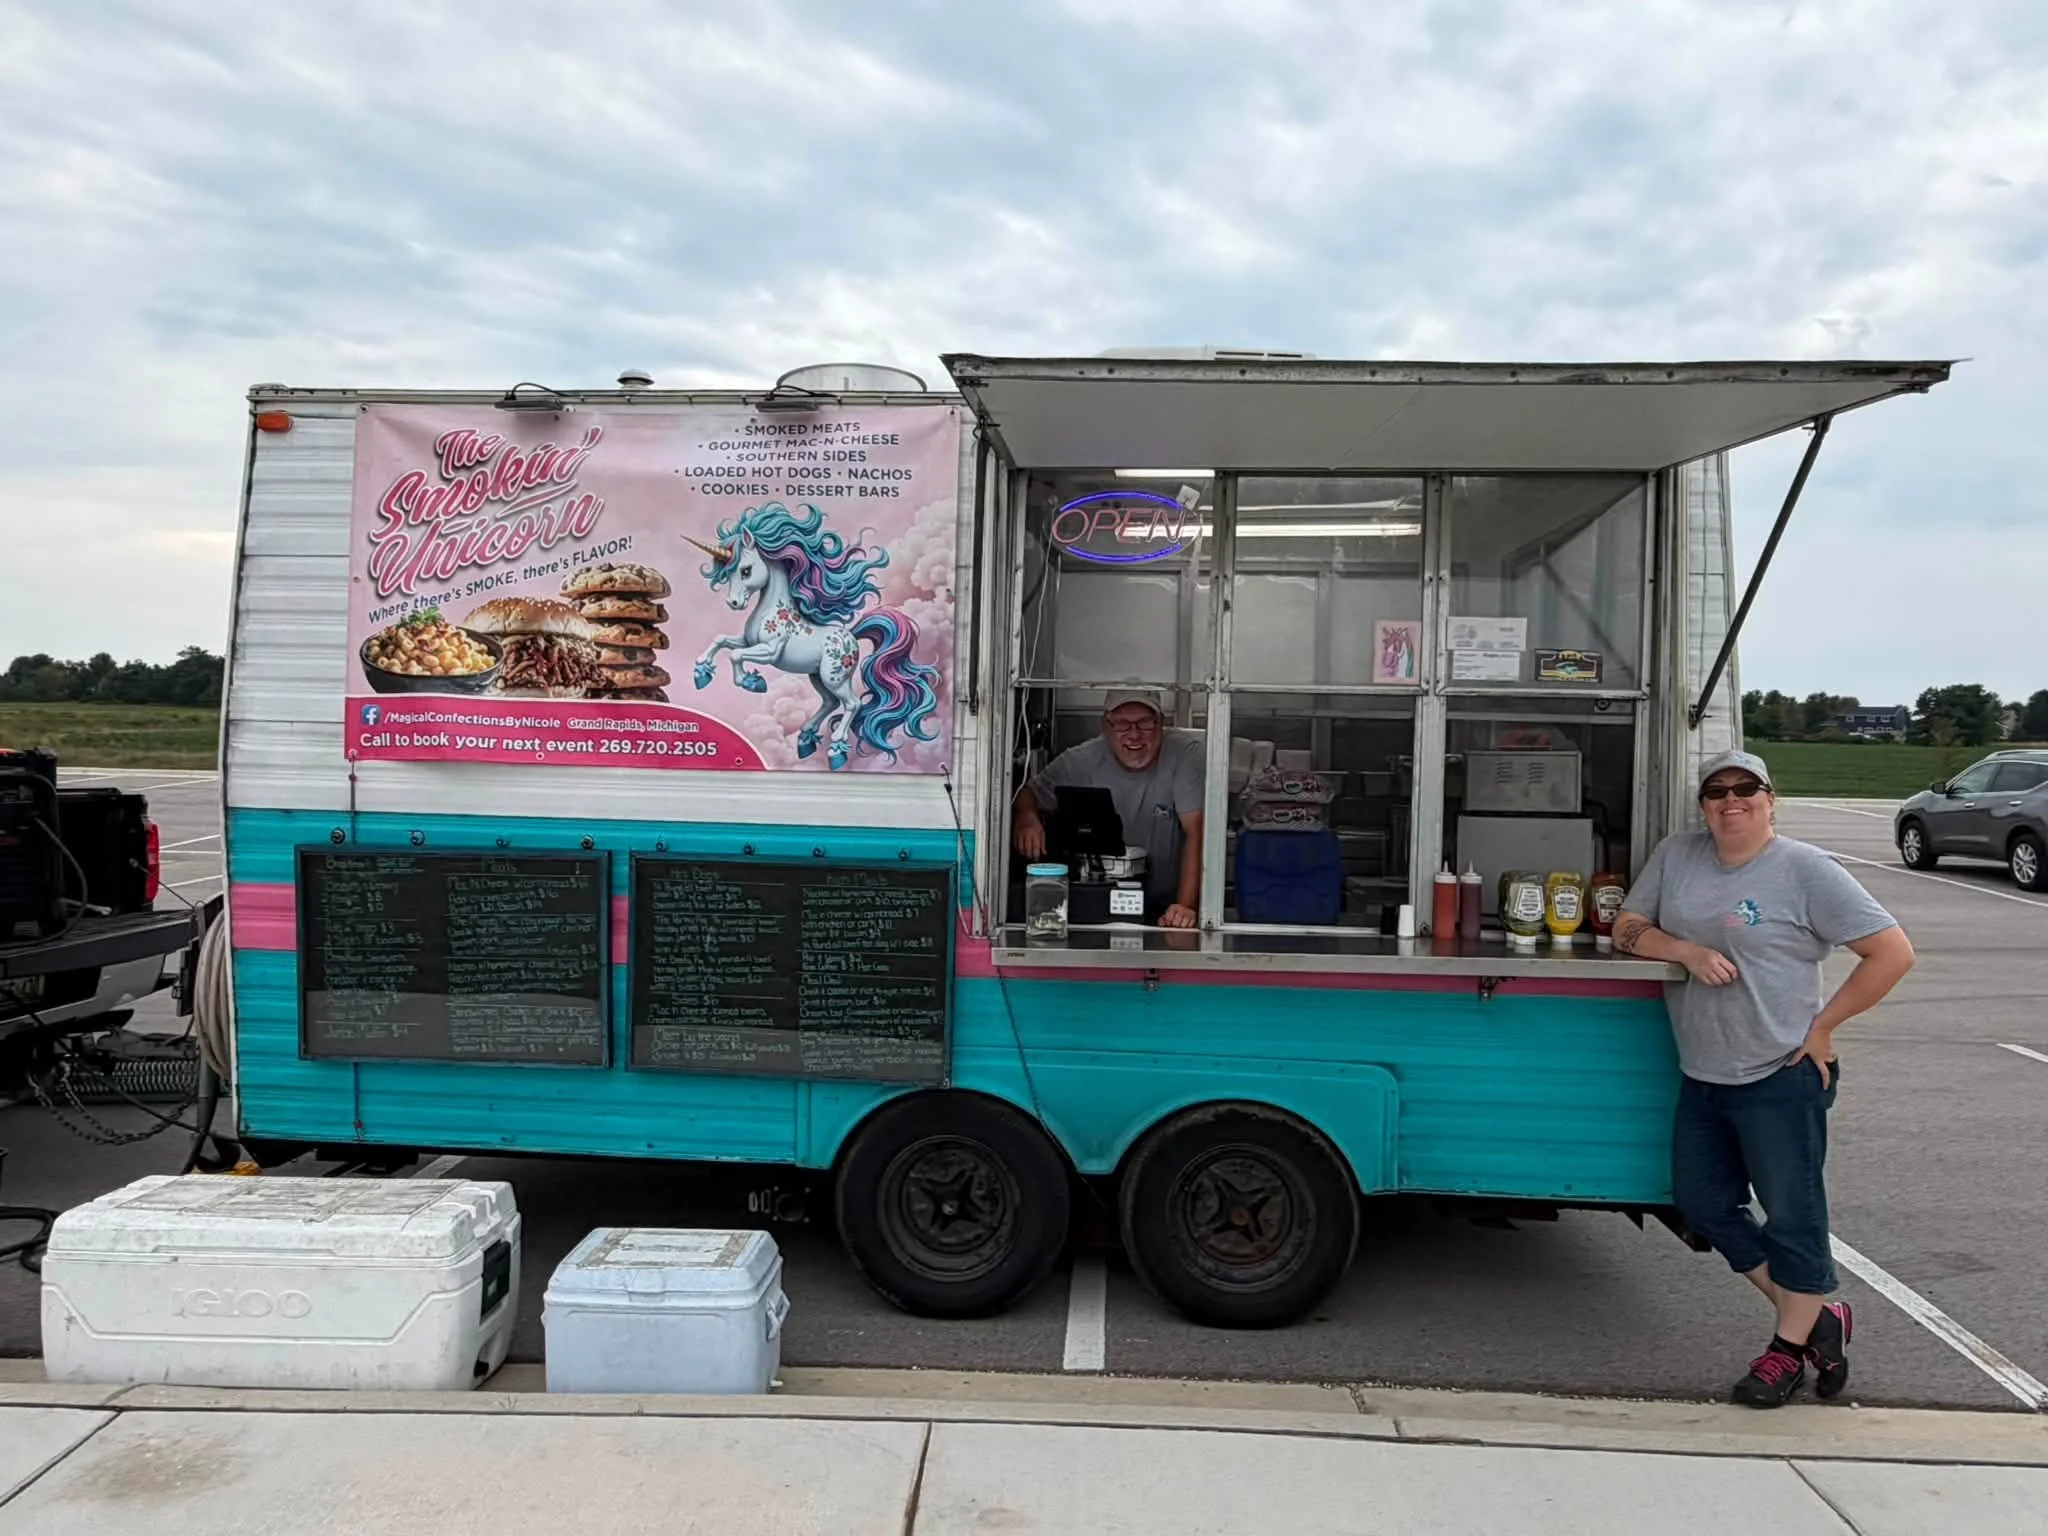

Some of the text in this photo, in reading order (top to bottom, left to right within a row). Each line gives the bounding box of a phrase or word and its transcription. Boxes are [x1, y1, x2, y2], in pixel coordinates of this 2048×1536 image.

[744, 422, 861, 436] SMOKED MEATS
[436, 428, 502, 478] The
[708, 434, 900, 451] GOURMET MAC-N-CHEESE
[735, 450, 867, 462] SOUTHERN SIDES
[370, 425, 602, 544] Smokin'
[684, 466, 913, 480] LOADED HOT DOGS NACHOS
[700, 483, 900, 498] COOKIES DESSERT BARS
[1052, 508, 1185, 544] OPEN
[369, 493, 604, 597] Unicorn
[368, 535, 633, 623] Where there's SMOKE, there's FLAVOR!
[384, 711, 561, 728] /MagicalConfectionsByNicole
[567, 718, 601, 729] Grand
[605, 719, 645, 732] Rapids,
[647, 719, 699, 733] Michigan
[360, 732, 717, 756] Call to book your next event 269.720.2505
[168, 1287, 312, 1319] IGLOO
